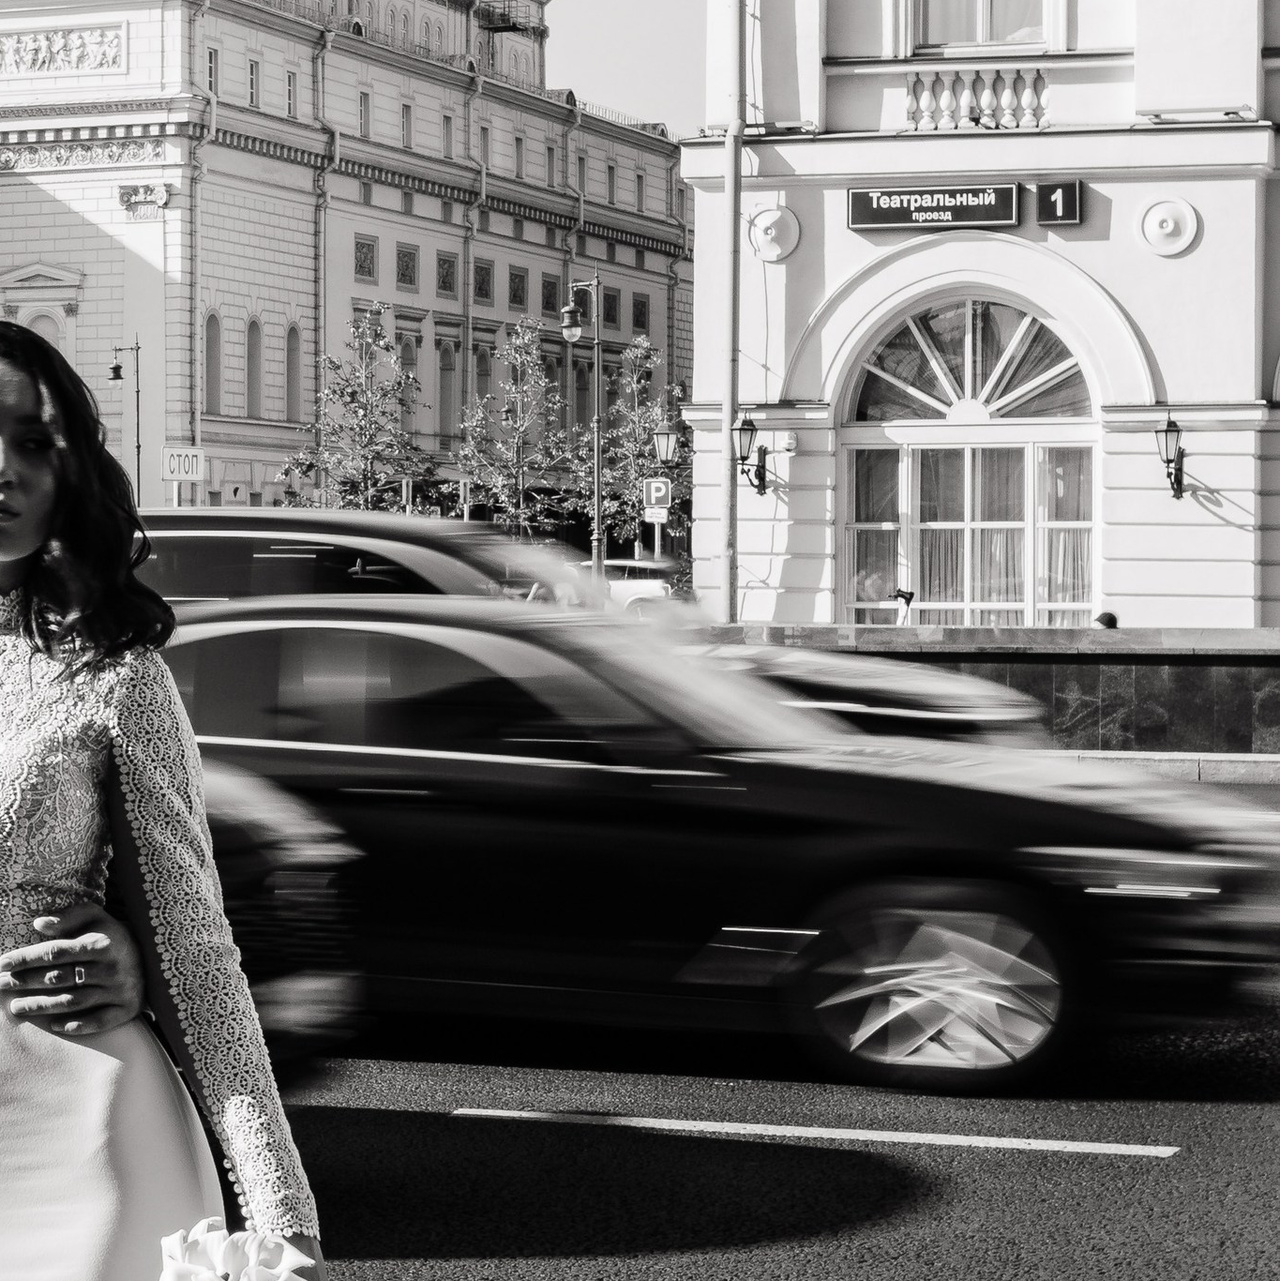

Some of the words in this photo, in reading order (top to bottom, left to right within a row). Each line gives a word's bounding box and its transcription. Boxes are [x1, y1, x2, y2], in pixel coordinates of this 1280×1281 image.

[869, 189, 996, 210] Театральный
[1050, 188, 1063, 217] 1
[912, 211, 952, 222] проезд
[168, 453, 199, 475] СТОП
[651, 482, 666, 504] P
